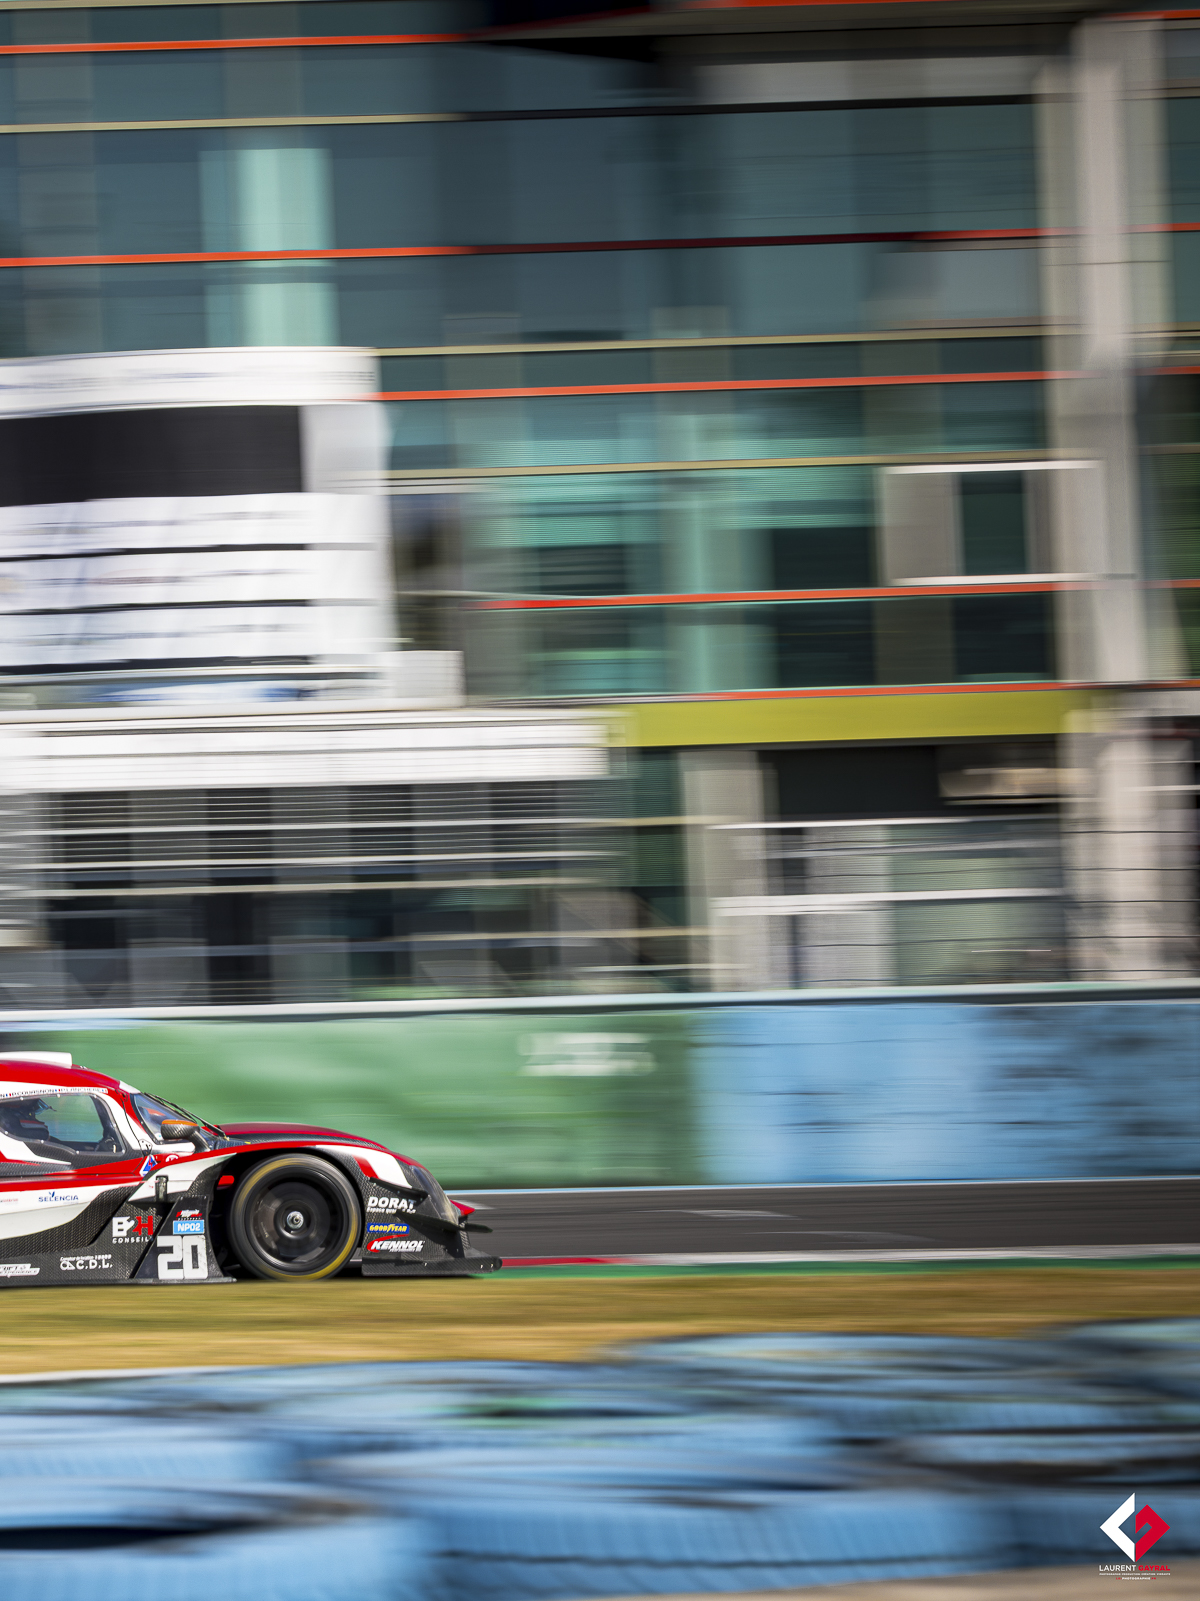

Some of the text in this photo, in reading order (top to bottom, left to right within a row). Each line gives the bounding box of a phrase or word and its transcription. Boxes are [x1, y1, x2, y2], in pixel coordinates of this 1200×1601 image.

[38, 1195, 79, 1203] SELENCIA
[112, 1236, 151, 1244] CONSEIL
[371, 1240, 424, 1250] KENNOL
[156, 1234, 209, 1280] 20
